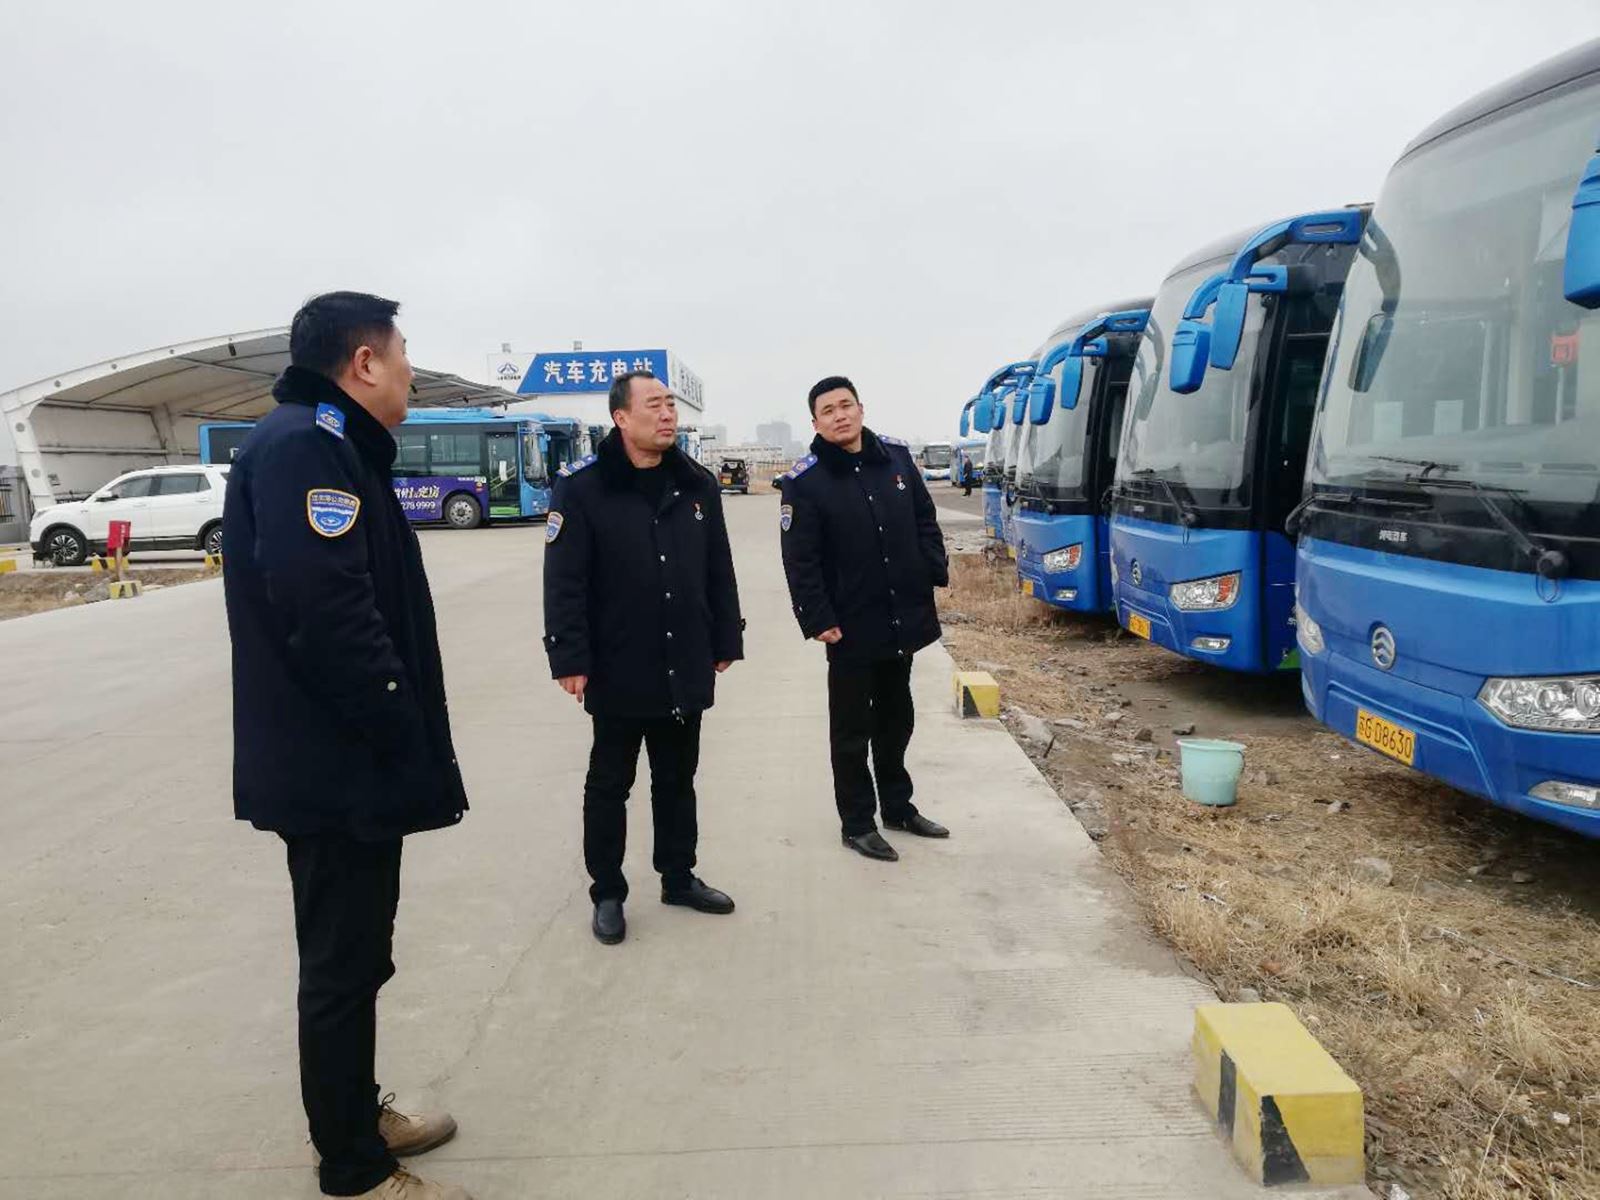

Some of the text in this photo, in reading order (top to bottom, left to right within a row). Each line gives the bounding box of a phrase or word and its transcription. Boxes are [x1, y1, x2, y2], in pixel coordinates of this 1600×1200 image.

[543, 357, 653, 384] 汽车充电站
